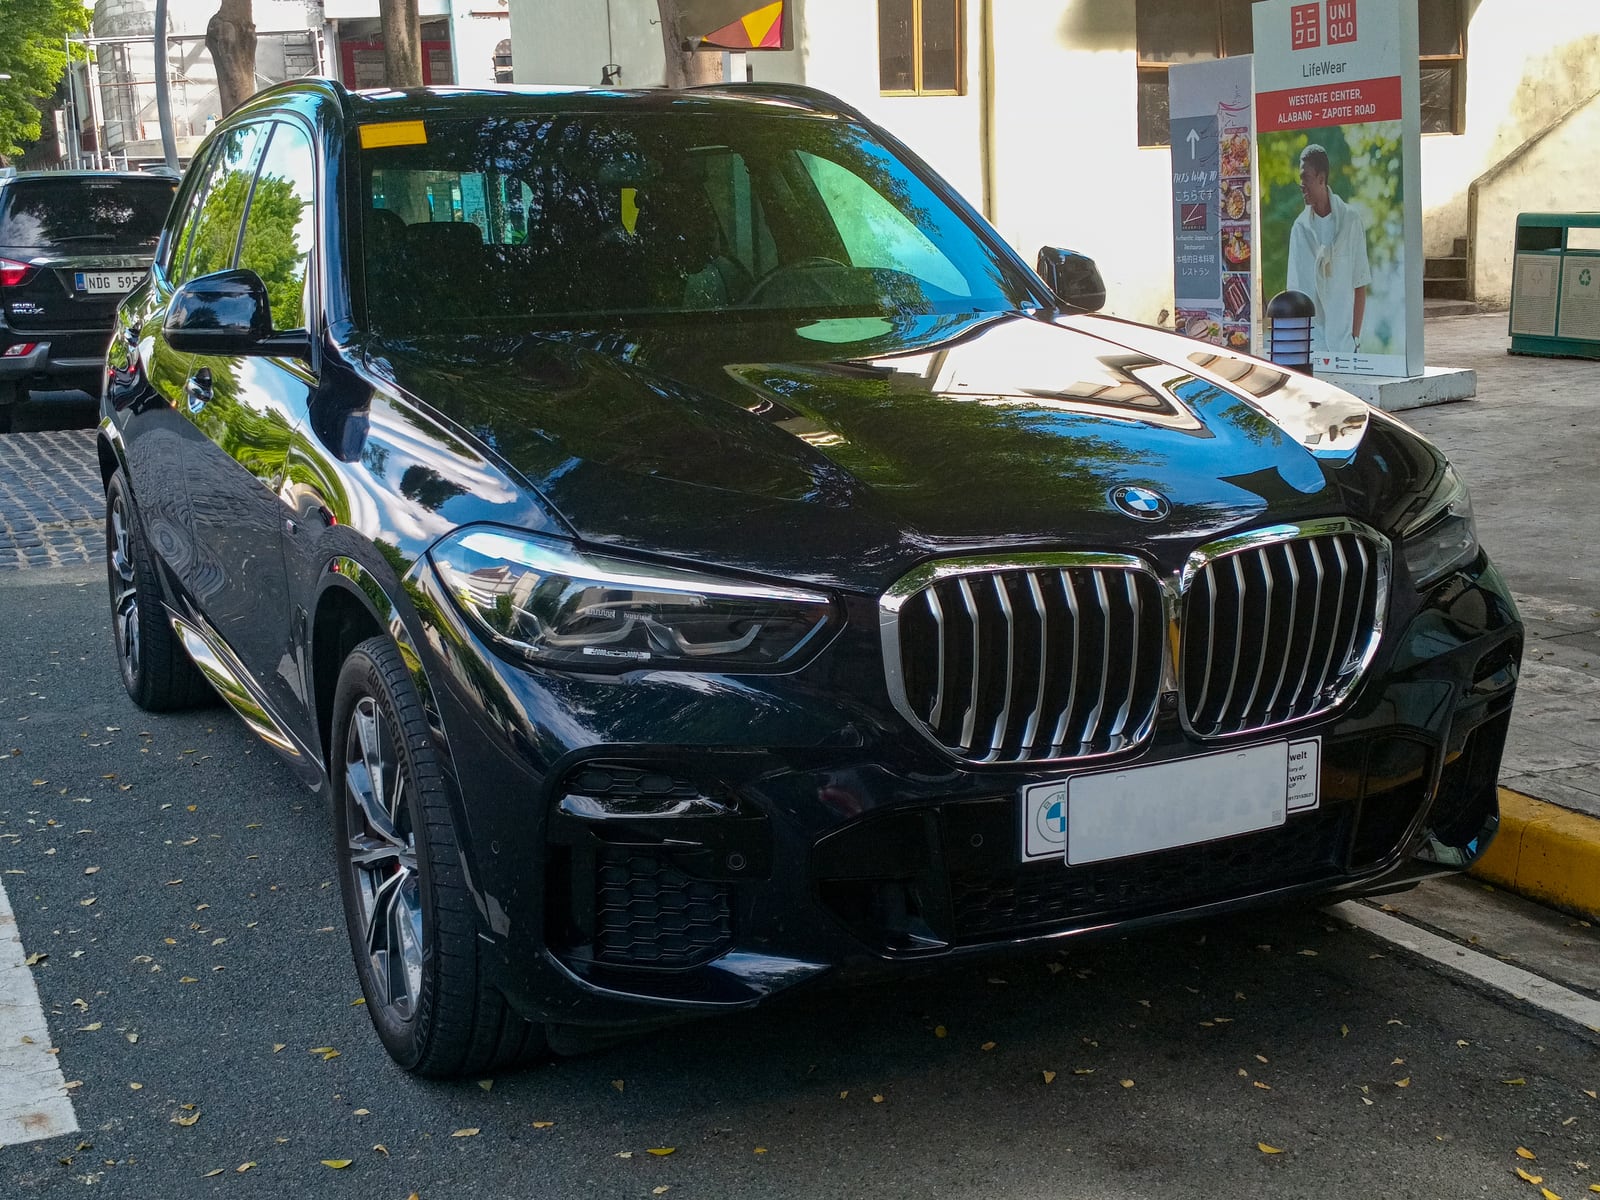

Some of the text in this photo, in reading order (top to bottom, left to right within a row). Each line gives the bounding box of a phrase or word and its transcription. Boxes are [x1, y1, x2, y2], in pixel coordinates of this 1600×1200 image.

[1329, 2, 1351, 20] UNI
[1330, 21, 1353, 41] QLO
[1302, 60, 1347, 78] LifeWear
[1288, 88, 1363, 106] WESTGATE CENTER,
[1278, 110, 1312, 124] ALABANG
[1322, 106, 1352, 119] ZAPOTE
[1354, 103, 1376, 116] ROAD
[88, 276, 110, 288] NDG
